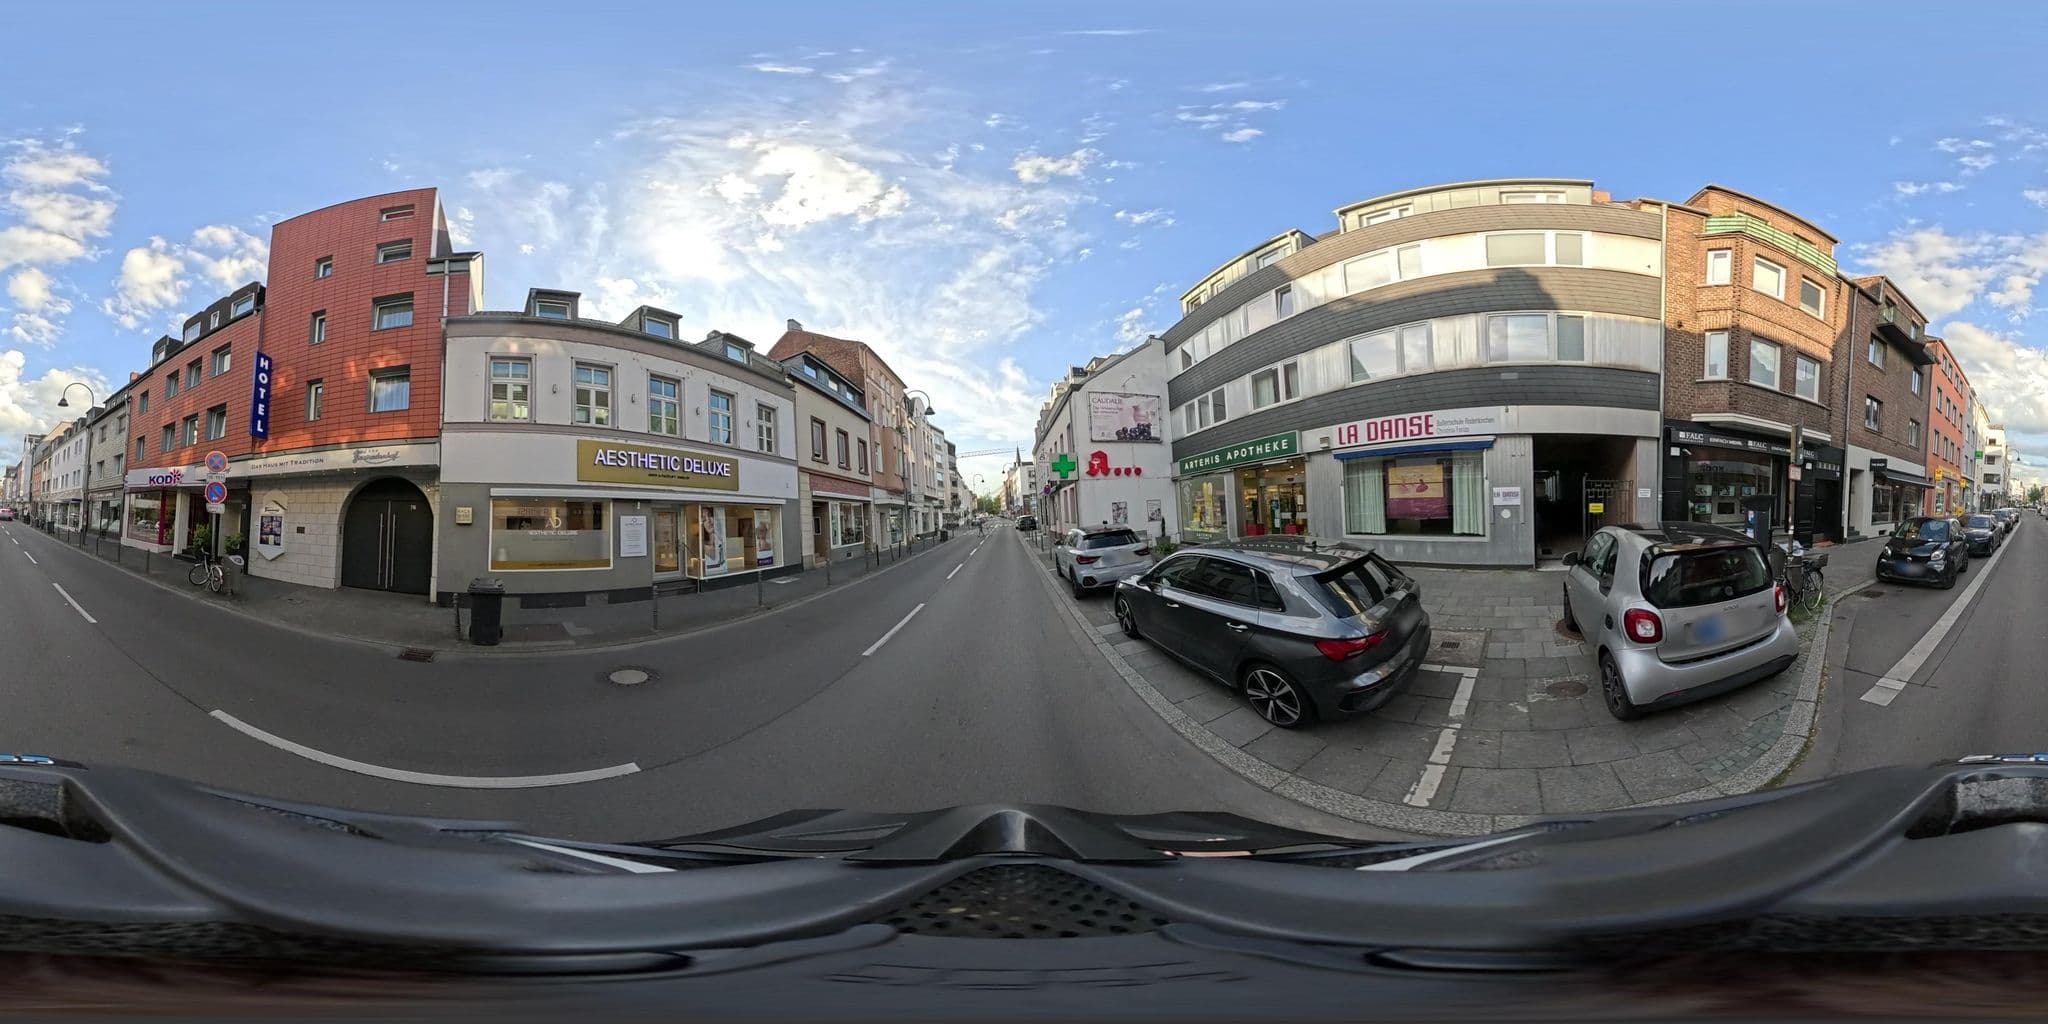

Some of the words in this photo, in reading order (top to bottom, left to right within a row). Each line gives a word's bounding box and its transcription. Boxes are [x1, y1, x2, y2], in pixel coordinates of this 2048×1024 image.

[257, 357, 269, 433] HOTEL
[1338, 424, 1358, 445] LA
[1367, 414, 1434, 442] DANSE
[1686, 431, 1704, 440] FALC
[594, 449, 681, 472] AESTHETIC
[683, 457, 731, 477] DELUXE
[1184, 454, 1220, 470] ARTEMIS
[1226, 439, 1289, 461] APOTHEKE
